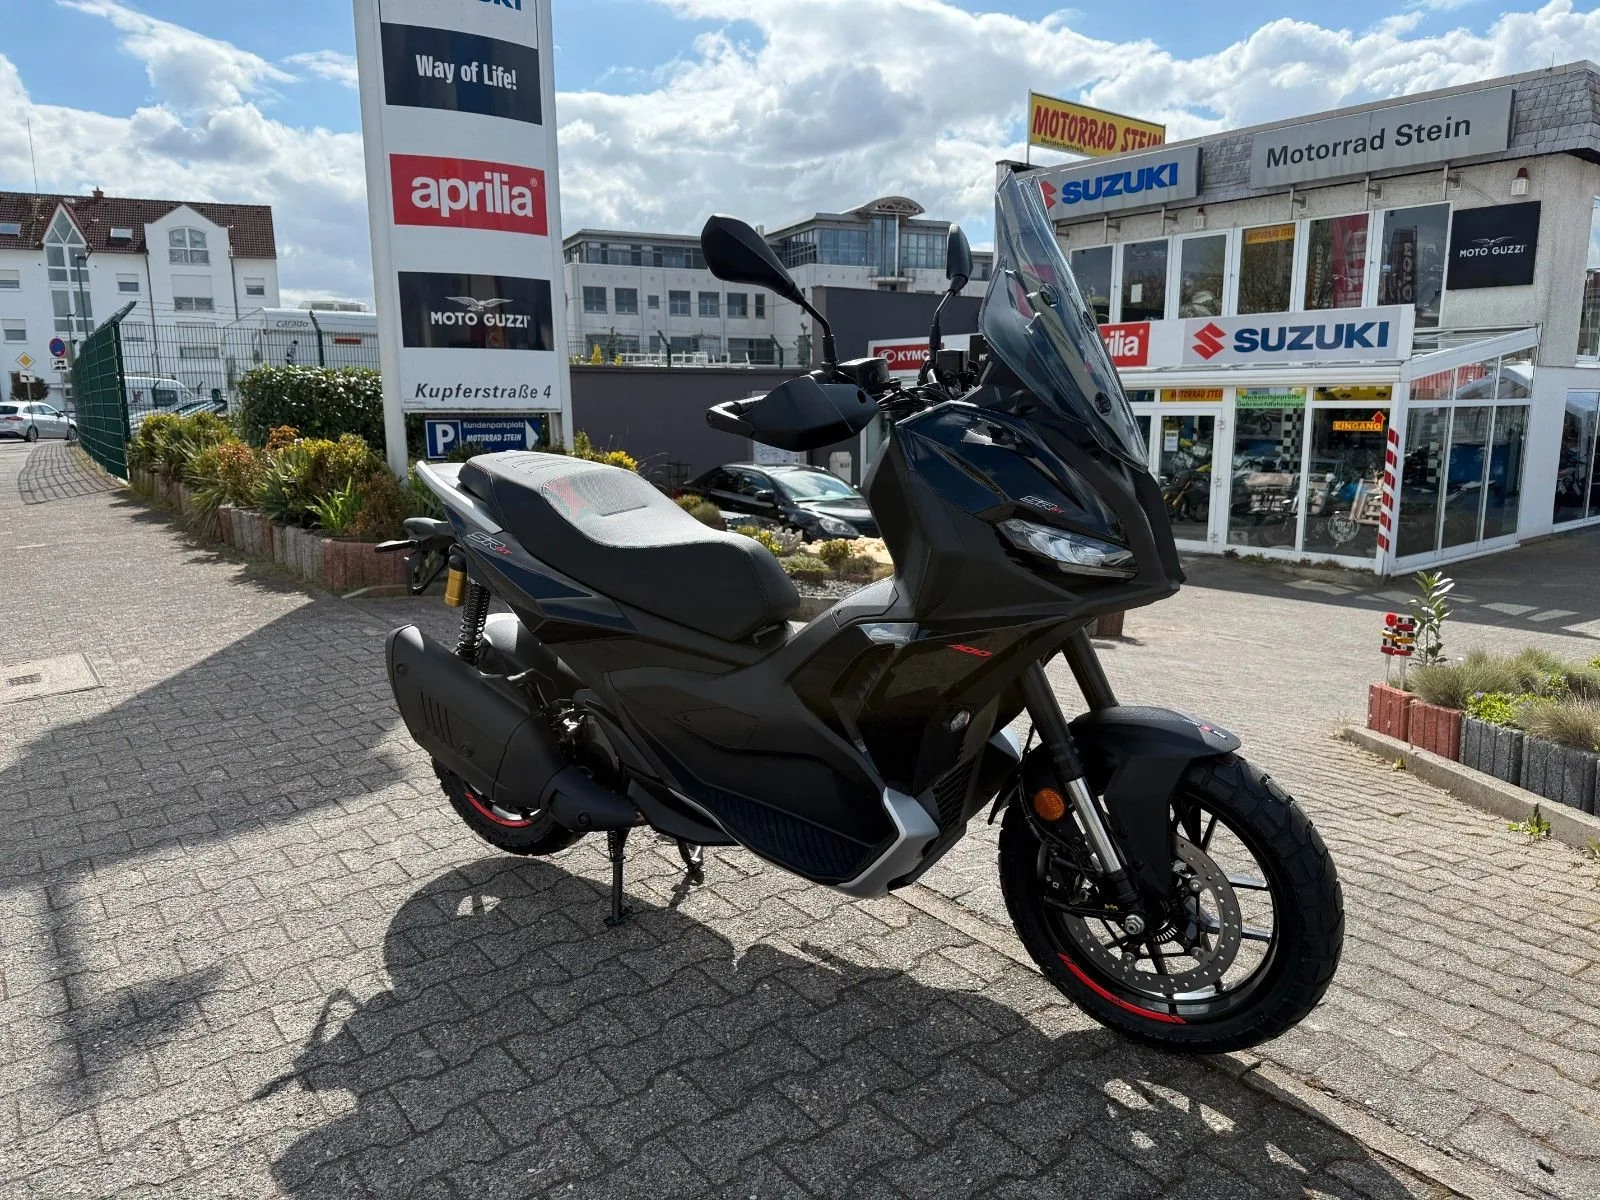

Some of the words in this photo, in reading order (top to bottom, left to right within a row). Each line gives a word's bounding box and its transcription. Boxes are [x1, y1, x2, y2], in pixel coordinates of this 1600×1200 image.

[416, 54, 454, 84] Way
[461, 61, 478, 83] of
[483, 63, 517, 91] Life!
[1032, 105, 1117, 151] MOTORRAD
[1041, 137, 1084, 153] Meisterbetrieb
[1266, 128, 1385, 168] Motorrad
[1395, 116, 1471, 147] Stein
[1062, 162, 1178, 204] SUZUKI
[411, 171, 534, 218] aprilia
[1459, 248, 1488, 258] MOTO
[1491, 245, 1525, 255] GUZZI
[276, 320, 309, 328] Carado
[430, 311, 477, 326] MOTO
[483, 313, 529, 328] GUZZI
[1233, 321, 1390, 353] SUZUKI
[897, 350, 931, 361] KYMC
[415, 383, 538, 401] Kupferstraße
[543, 385, 552, 399] 4
[463, 421, 525, 430] Kundenparkplatz
[1335, 422, 1381, 430] EINGANG
[435, 423, 455, 455] P
[466, 434, 502, 442] MOTORRAD
[503, 433, 522, 441] STEIN
